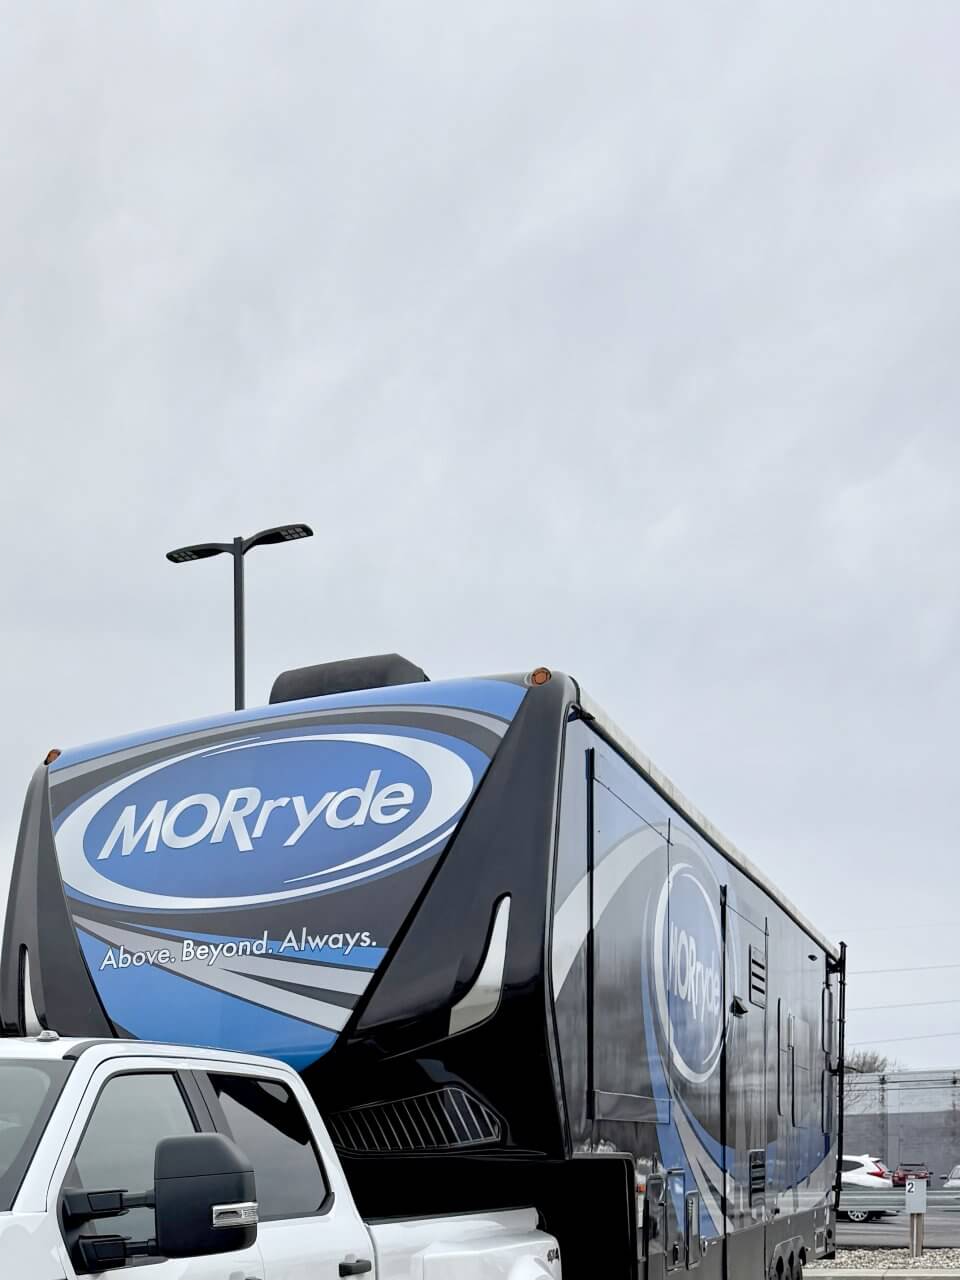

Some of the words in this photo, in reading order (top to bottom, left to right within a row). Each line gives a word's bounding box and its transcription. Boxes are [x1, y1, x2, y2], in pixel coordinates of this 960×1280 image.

[97, 769, 415, 860] MORryde
[99, 945, 176, 970] Above.
[181, 930, 273, 965] Beyond.
[279, 927, 377, 953] Always.
[907, 1182, 915, 1193] 2
